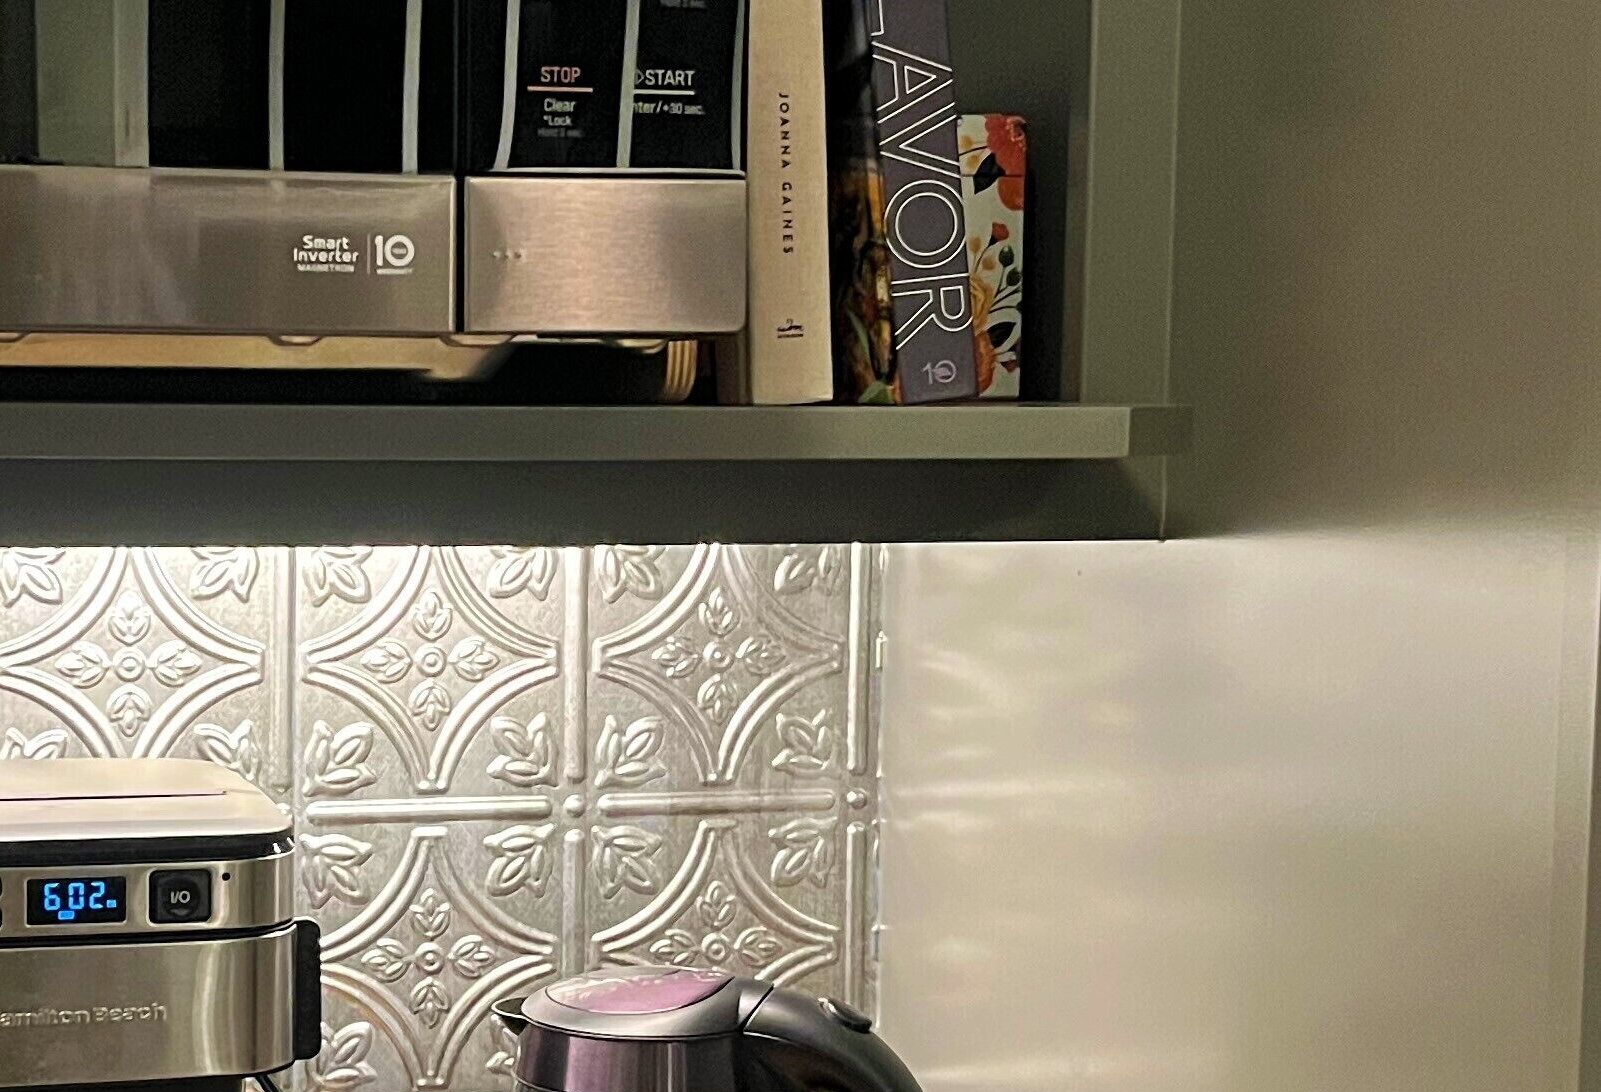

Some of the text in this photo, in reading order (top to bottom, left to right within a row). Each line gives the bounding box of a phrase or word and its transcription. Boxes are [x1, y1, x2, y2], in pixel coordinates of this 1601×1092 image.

[540, 66, 581, 83] STOP
[645, 69, 696, 86] START
[543, 97, 576, 112] Clear
[778, 92, 794, 254] JOANNA GAINES
[302, 234, 350, 250] Smart
[374, 234, 415, 267] 10
[293, 247, 359, 263] Inverter
[93, 1002, 167, 1022] Beach
